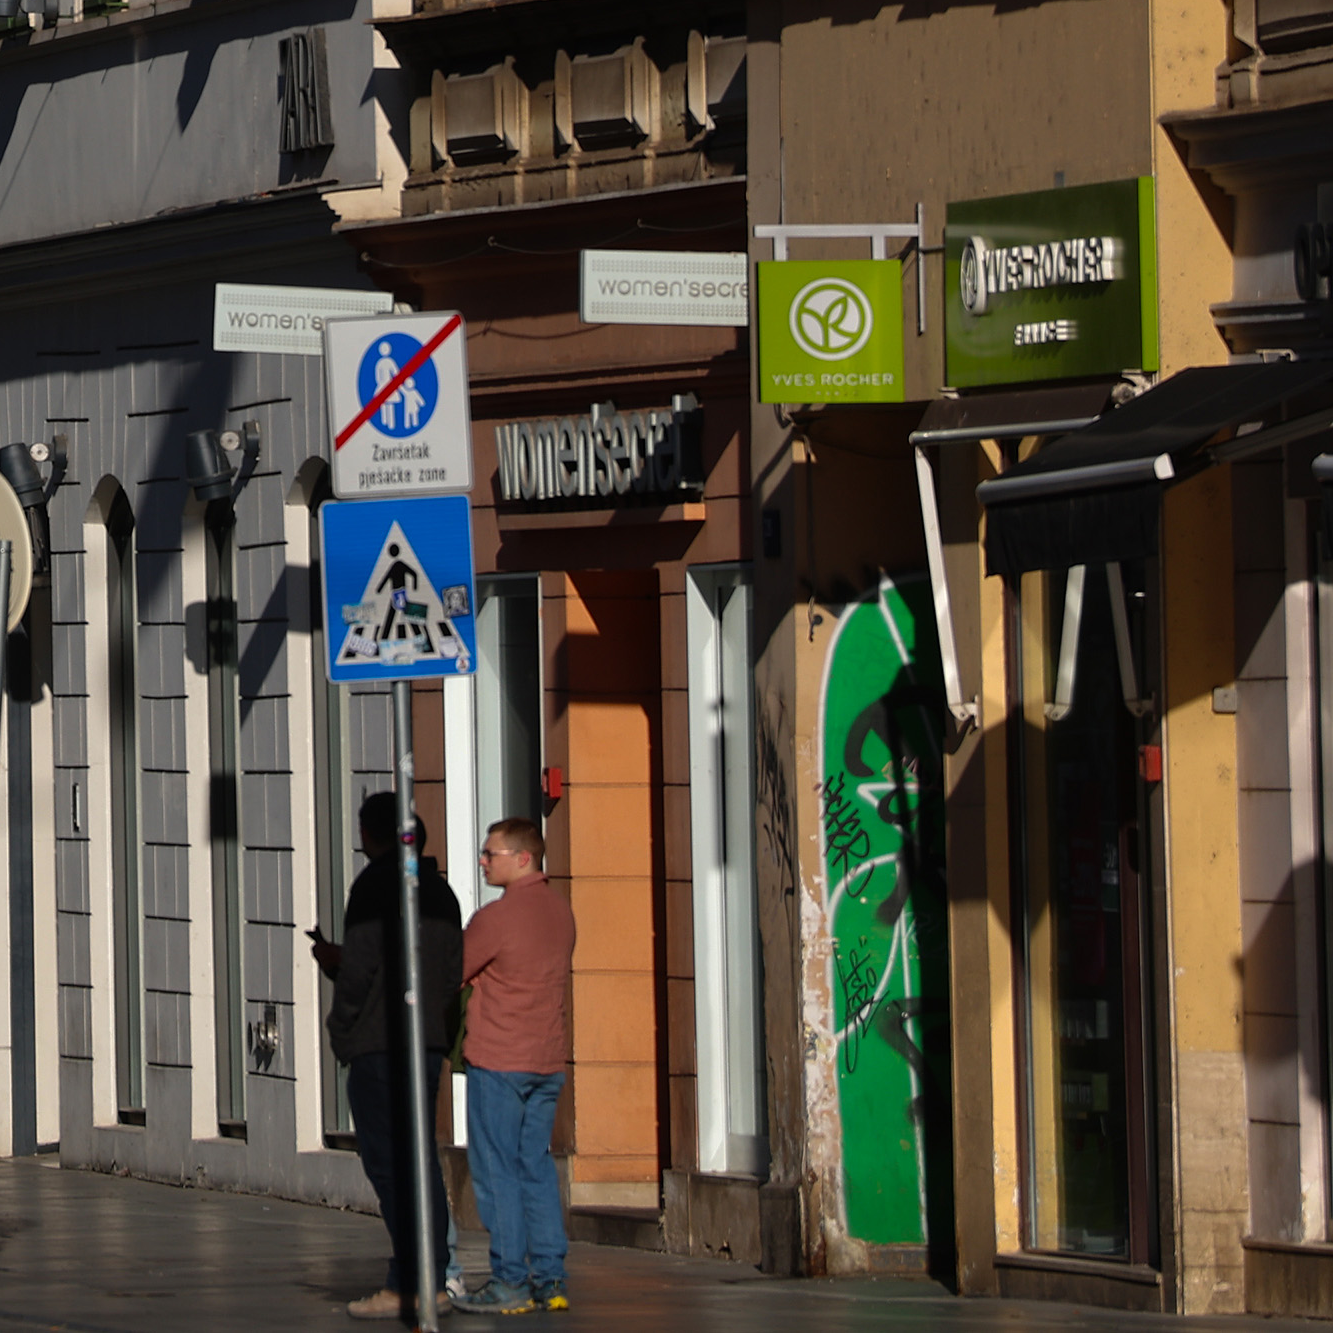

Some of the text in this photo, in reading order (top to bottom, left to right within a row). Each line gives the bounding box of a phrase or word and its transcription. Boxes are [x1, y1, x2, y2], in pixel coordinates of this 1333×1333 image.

[227, 310, 323, 330] women's
[772, 372, 894, 386] YVES ROCHER
[419, 467, 446, 481] zone
